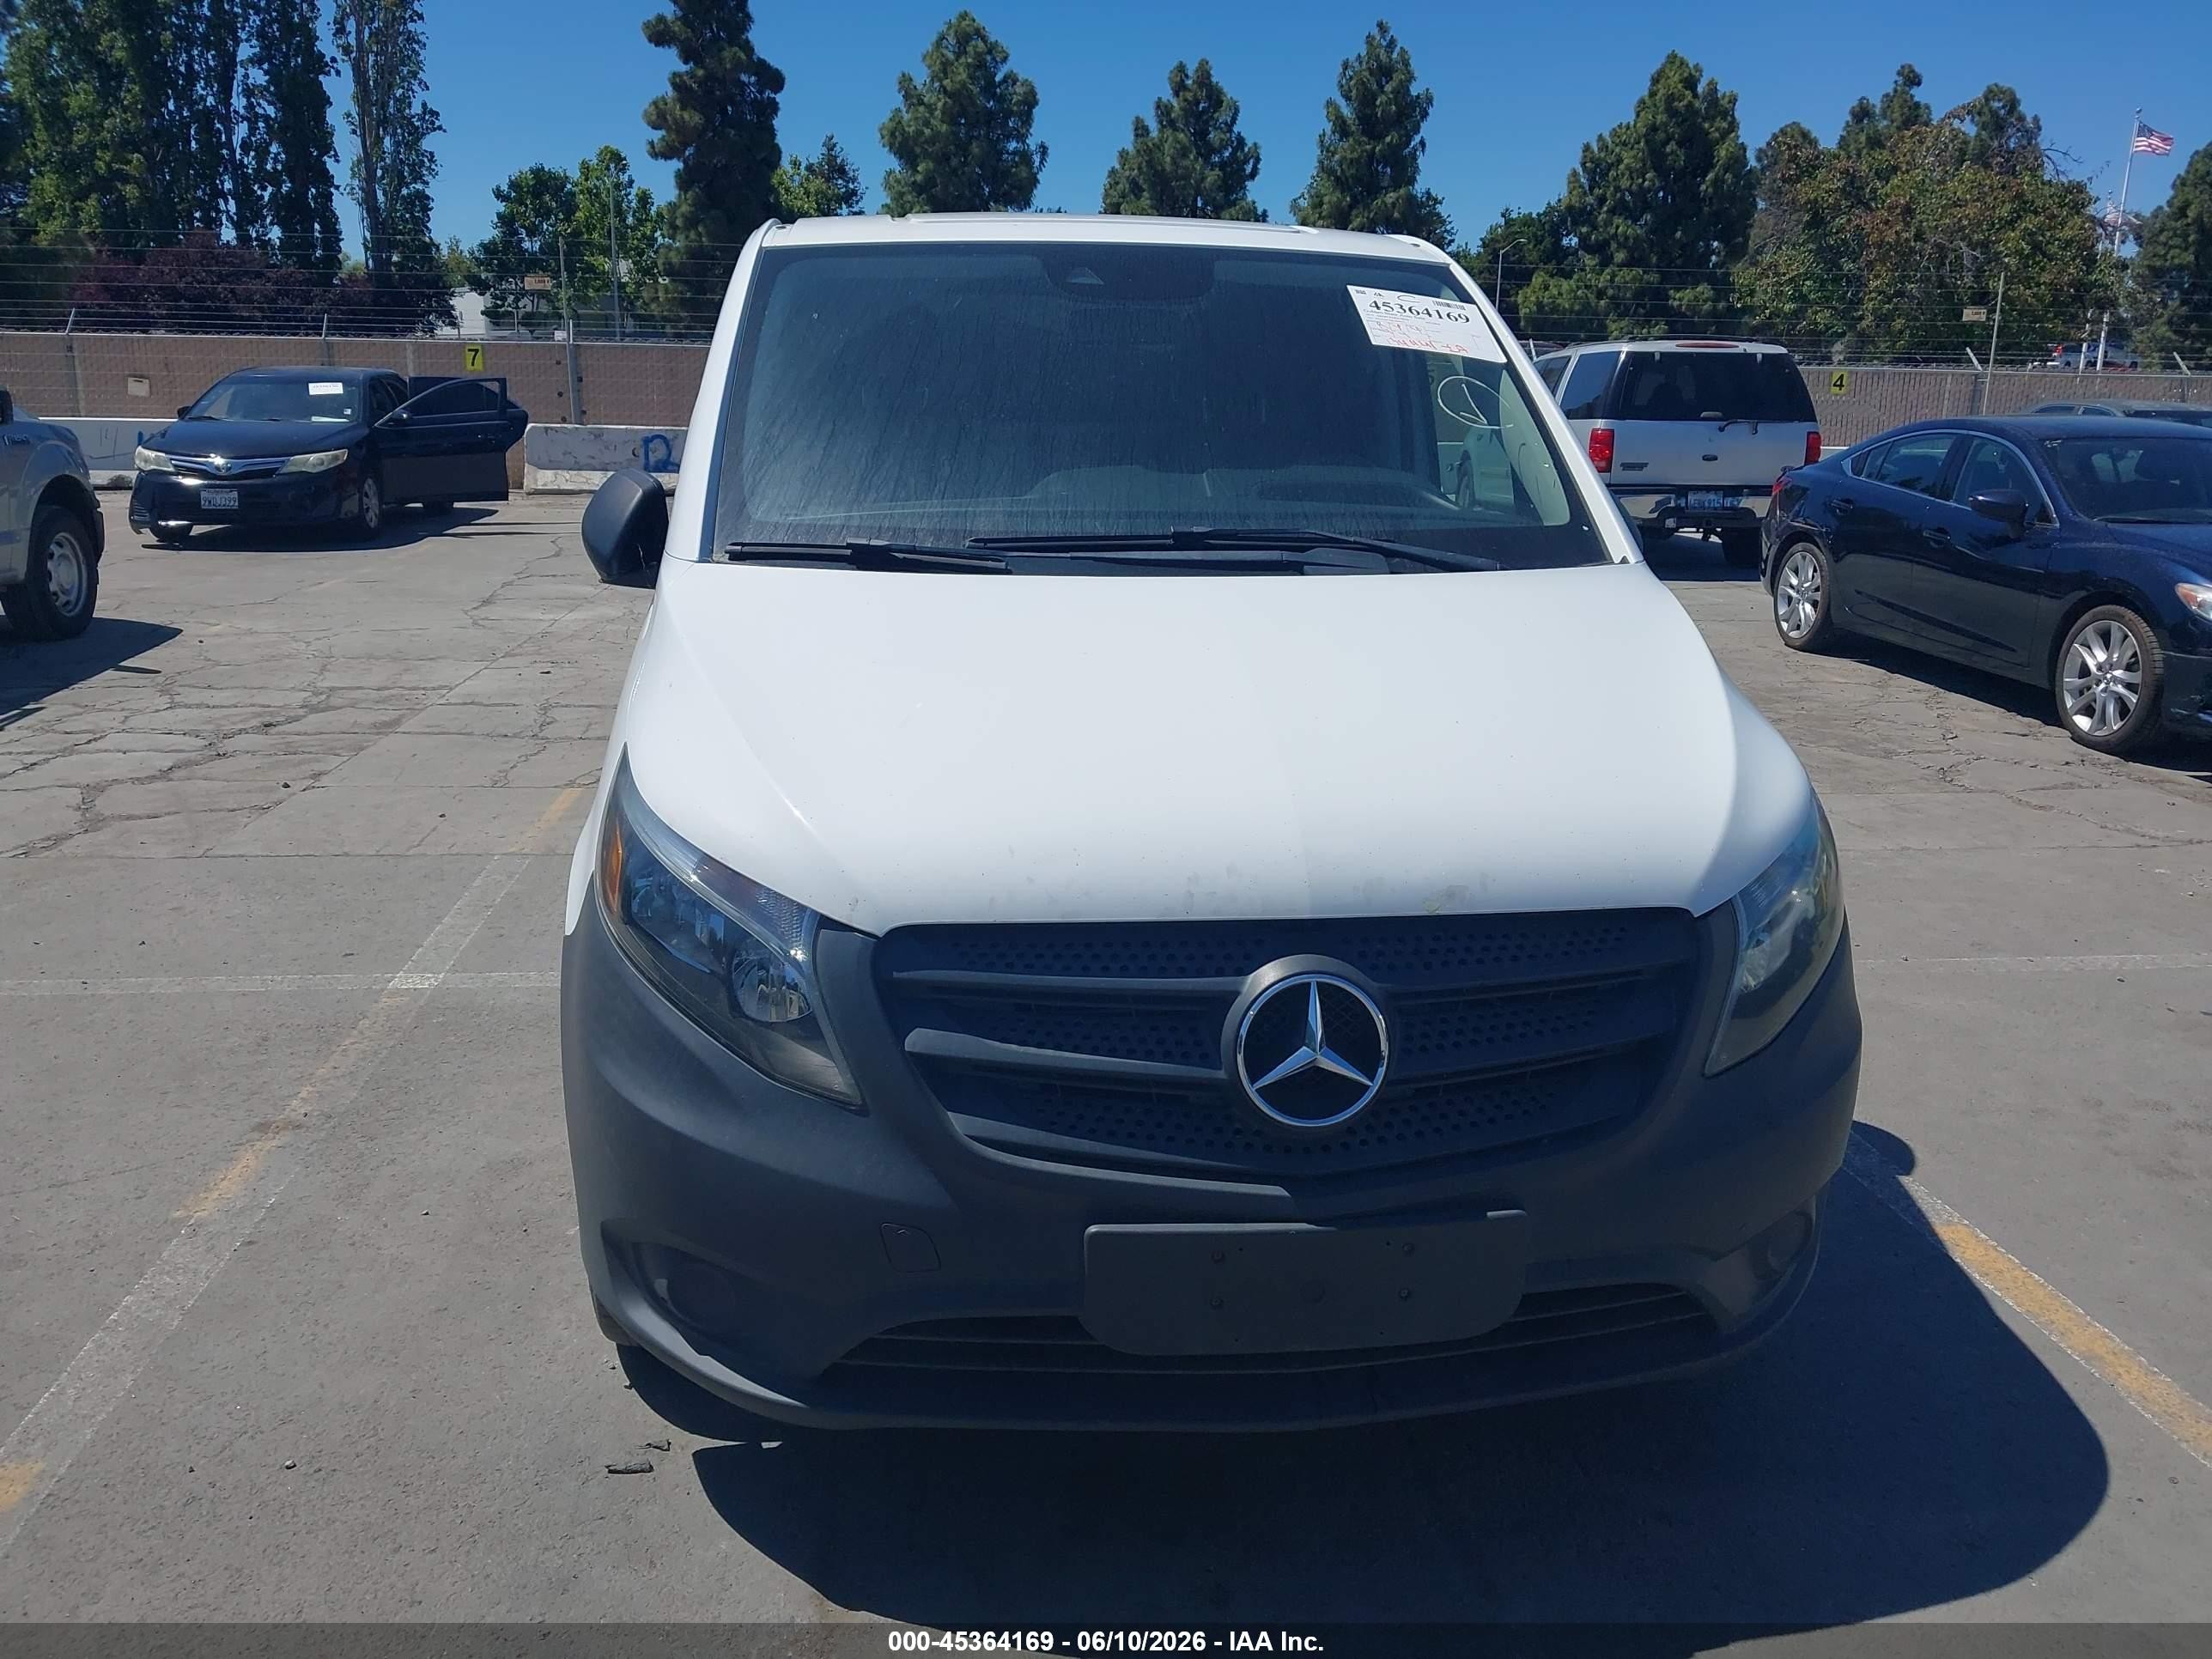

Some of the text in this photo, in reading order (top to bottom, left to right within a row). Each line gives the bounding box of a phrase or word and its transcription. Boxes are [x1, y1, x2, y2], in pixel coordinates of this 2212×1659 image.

[1369, 300, 1470, 324] 45364169
[466, 348, 480, 367] 7
[1832, 374, 1845, 391] 4
